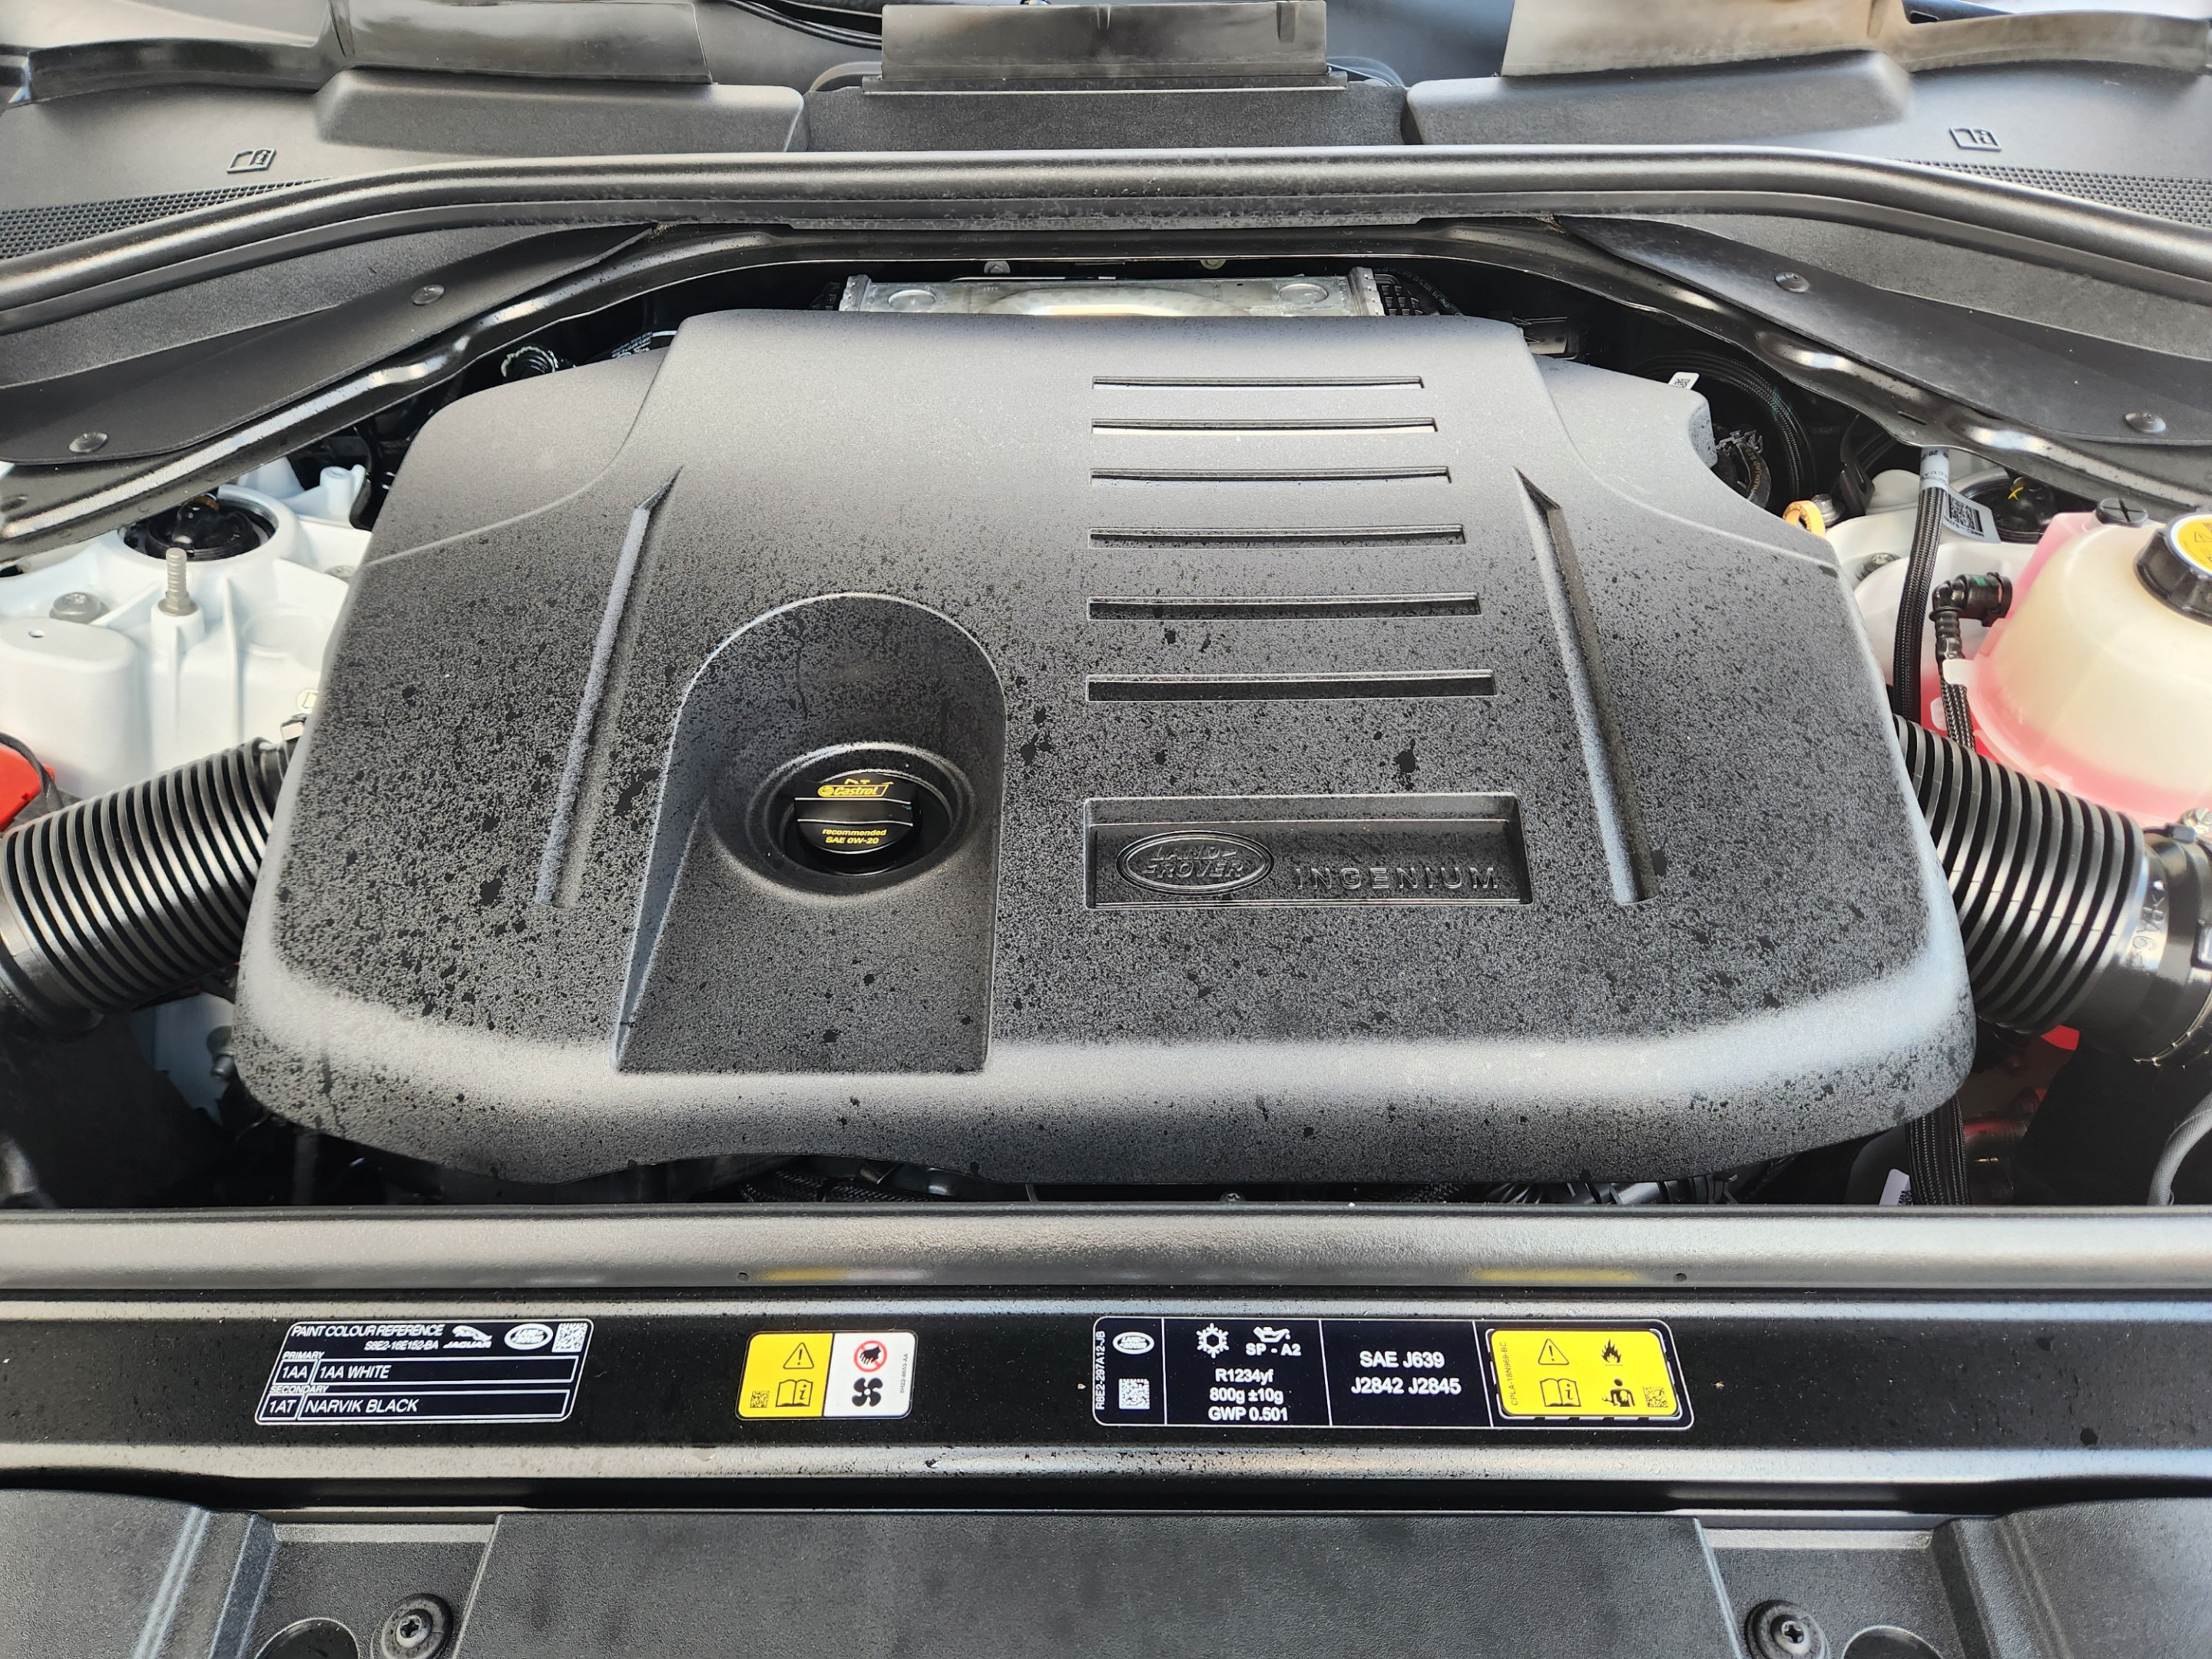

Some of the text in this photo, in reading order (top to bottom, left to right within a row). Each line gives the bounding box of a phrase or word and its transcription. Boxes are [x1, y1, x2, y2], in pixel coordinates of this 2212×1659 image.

[833, 786, 879, 796] Castrol
[1296, 867, 1498, 889] INGENIUM
[290, 1323, 445, 1337] PAINT COLOUR REFERENCE
[282, 1351, 325, 1359] PRIMARY
[1359, 1350, 1445, 1369] SAE J639
[282, 1366, 309, 1379] 1AA
[320, 1365, 392, 1379] 1AA WHITE
[1095, 1331, 1105, 1410] R8E2-297A12-JB
[1215, 1368, 1274, 1386] R1234yf
[269, 1385, 329, 1394] SECONDARY
[1350, 1376, 1462, 1395] J2842 J2845
[1209, 1387, 1284, 1405] 800g ±10g
[269, 1399, 296, 1413] 1AT
[304, 1399, 419, 1413] NARVIK BLACK
[1208, 1406, 1288, 1422] GWP 0.501
